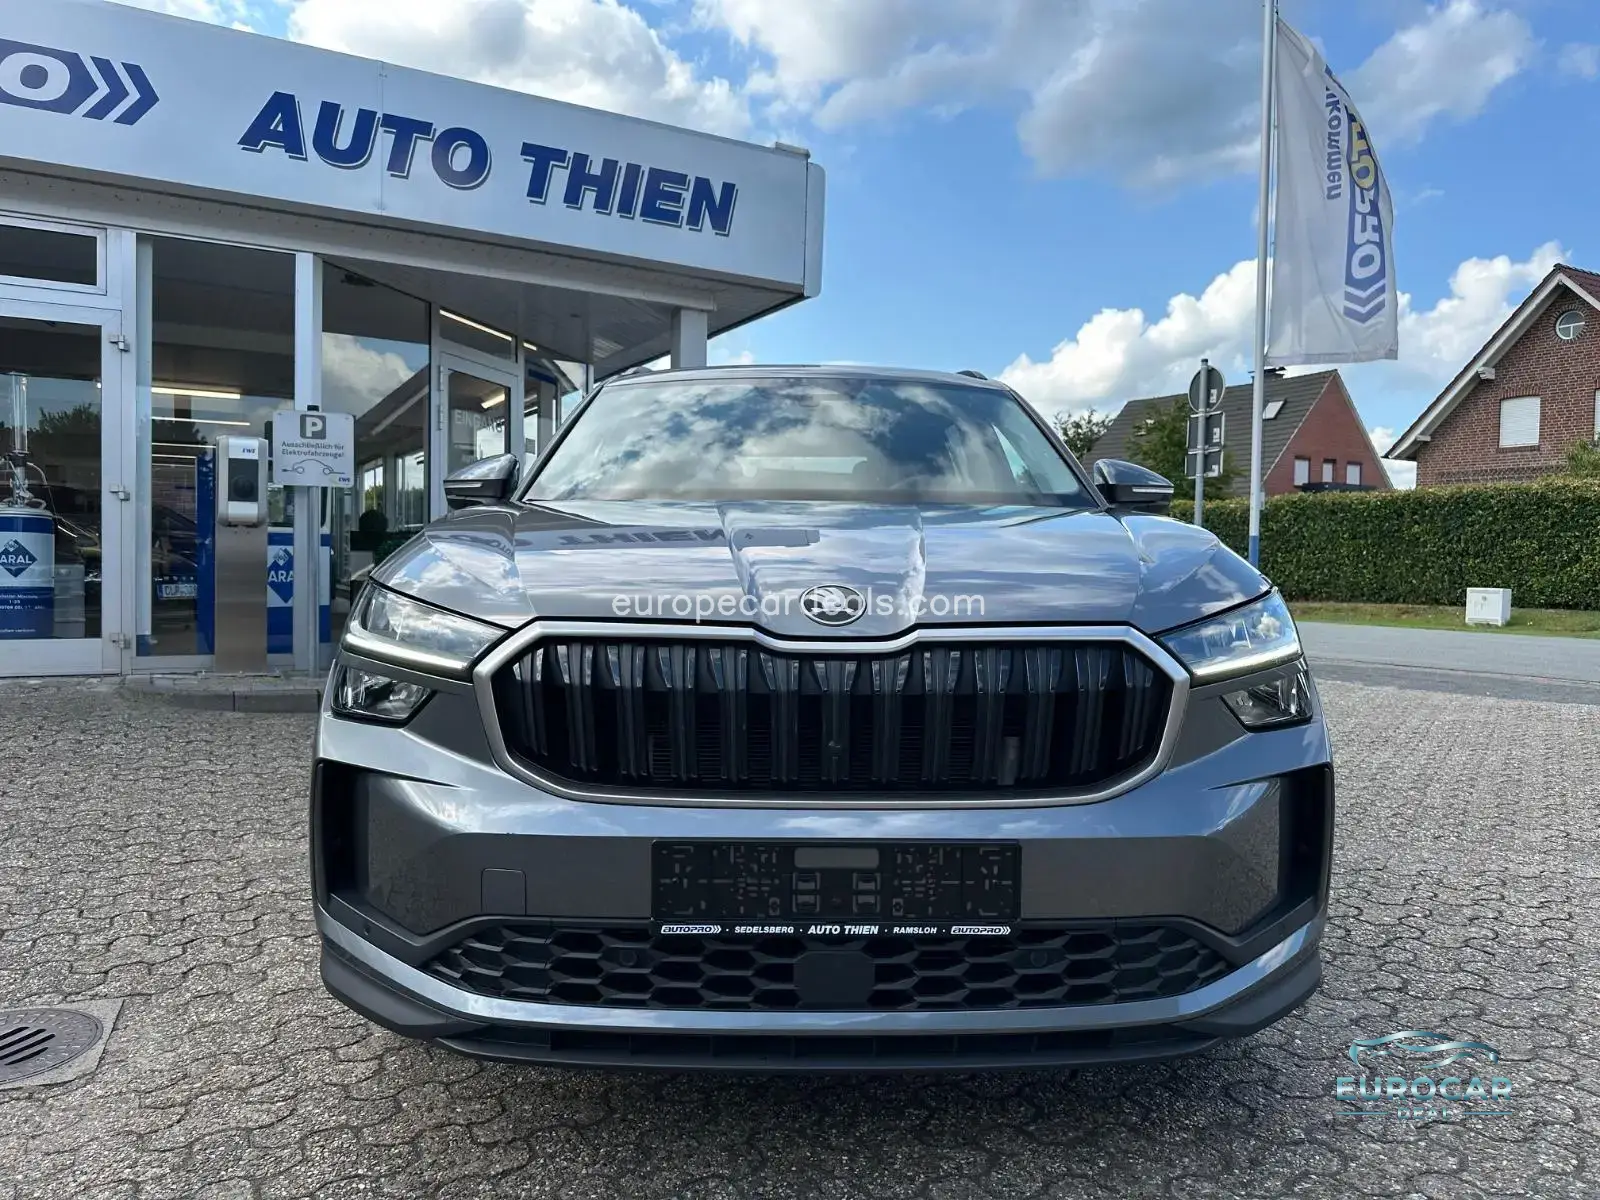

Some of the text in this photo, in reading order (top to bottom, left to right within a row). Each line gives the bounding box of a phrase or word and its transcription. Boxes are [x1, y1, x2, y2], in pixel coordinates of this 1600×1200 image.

[237, 90, 738, 237] AUTO THIEN
[305, 416, 323, 438] P
[0, 554, 32, 564] ARAL
[268, 570, 294, 583] ARA
[735, 926, 794, 934] SEDELSBERG
[807, 925, 840, 934] AUTO
[844, 925, 879, 935] THIEN
[893, 926, 938, 934] RAMSLOH
